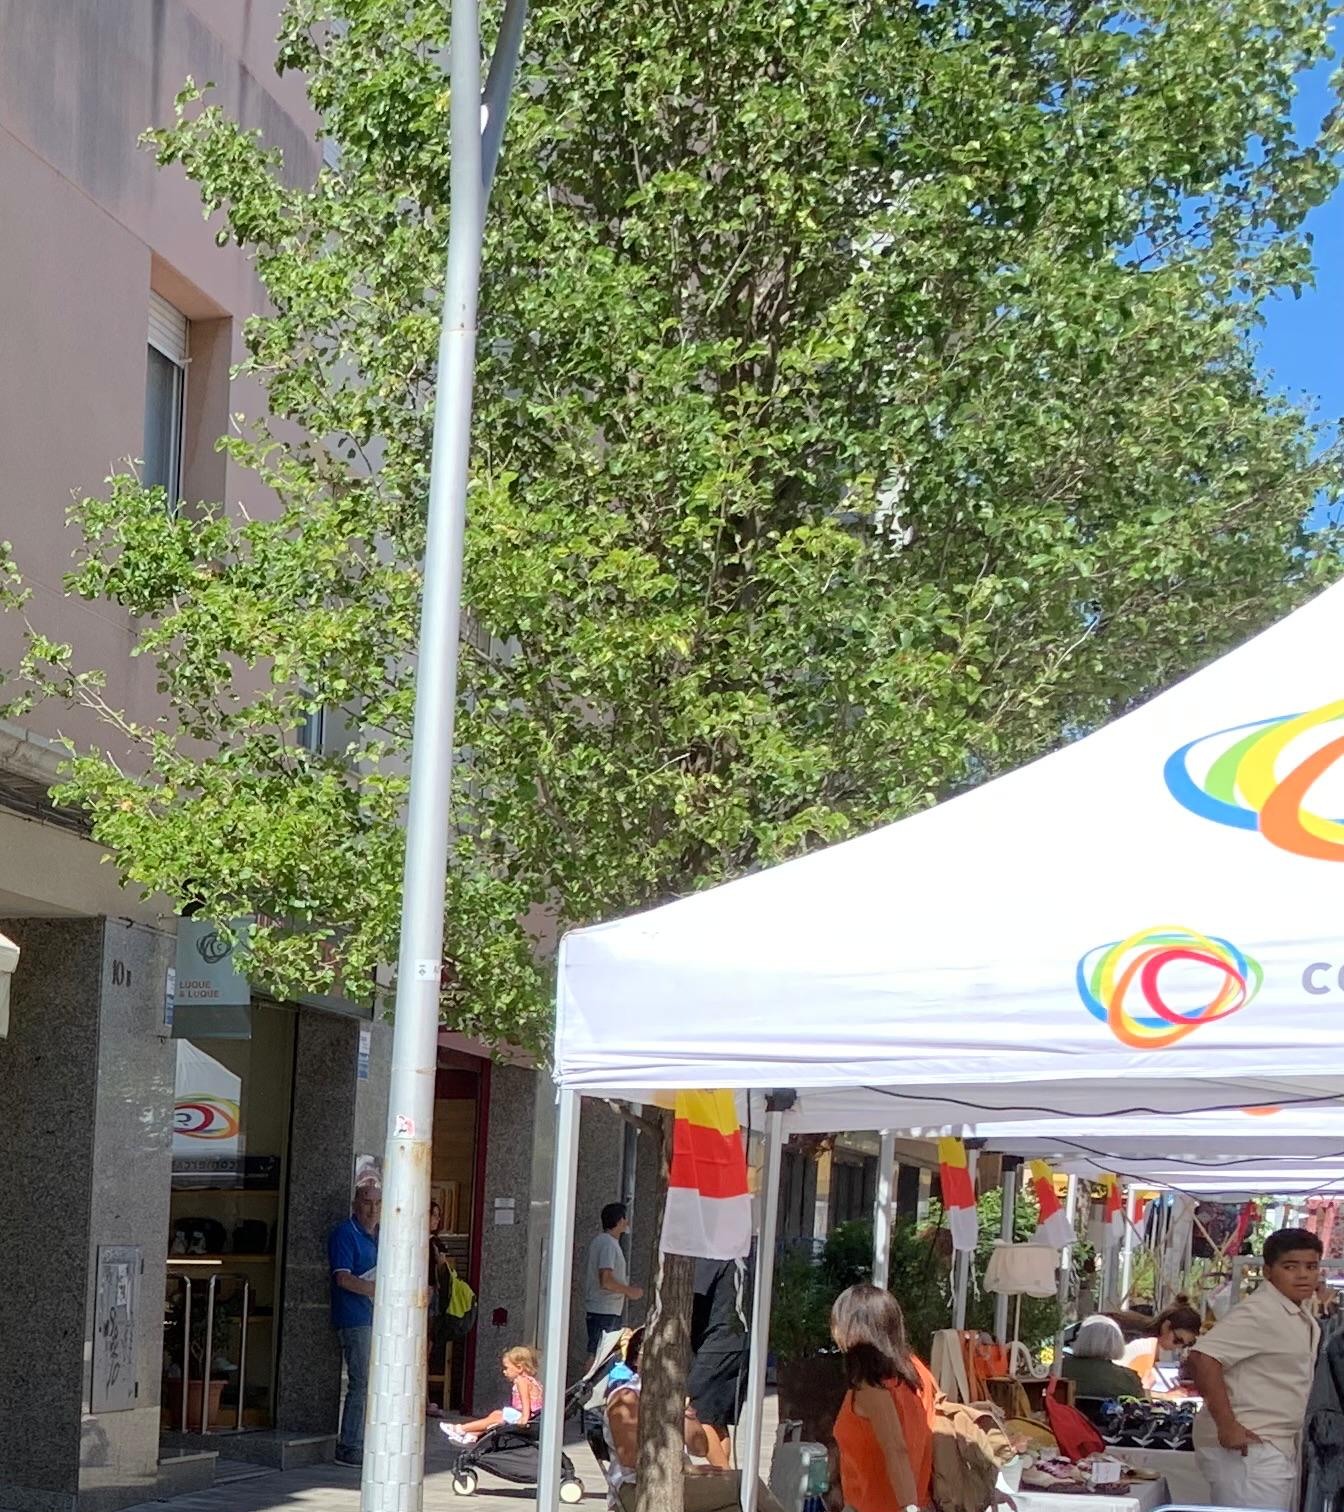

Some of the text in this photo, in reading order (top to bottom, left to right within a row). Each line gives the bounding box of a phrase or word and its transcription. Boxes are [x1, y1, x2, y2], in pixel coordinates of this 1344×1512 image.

[1301, 961, 1344, 995] c
[179, 980, 211, 989] LUQUE
[188, 990, 221, 998] LUQUE
